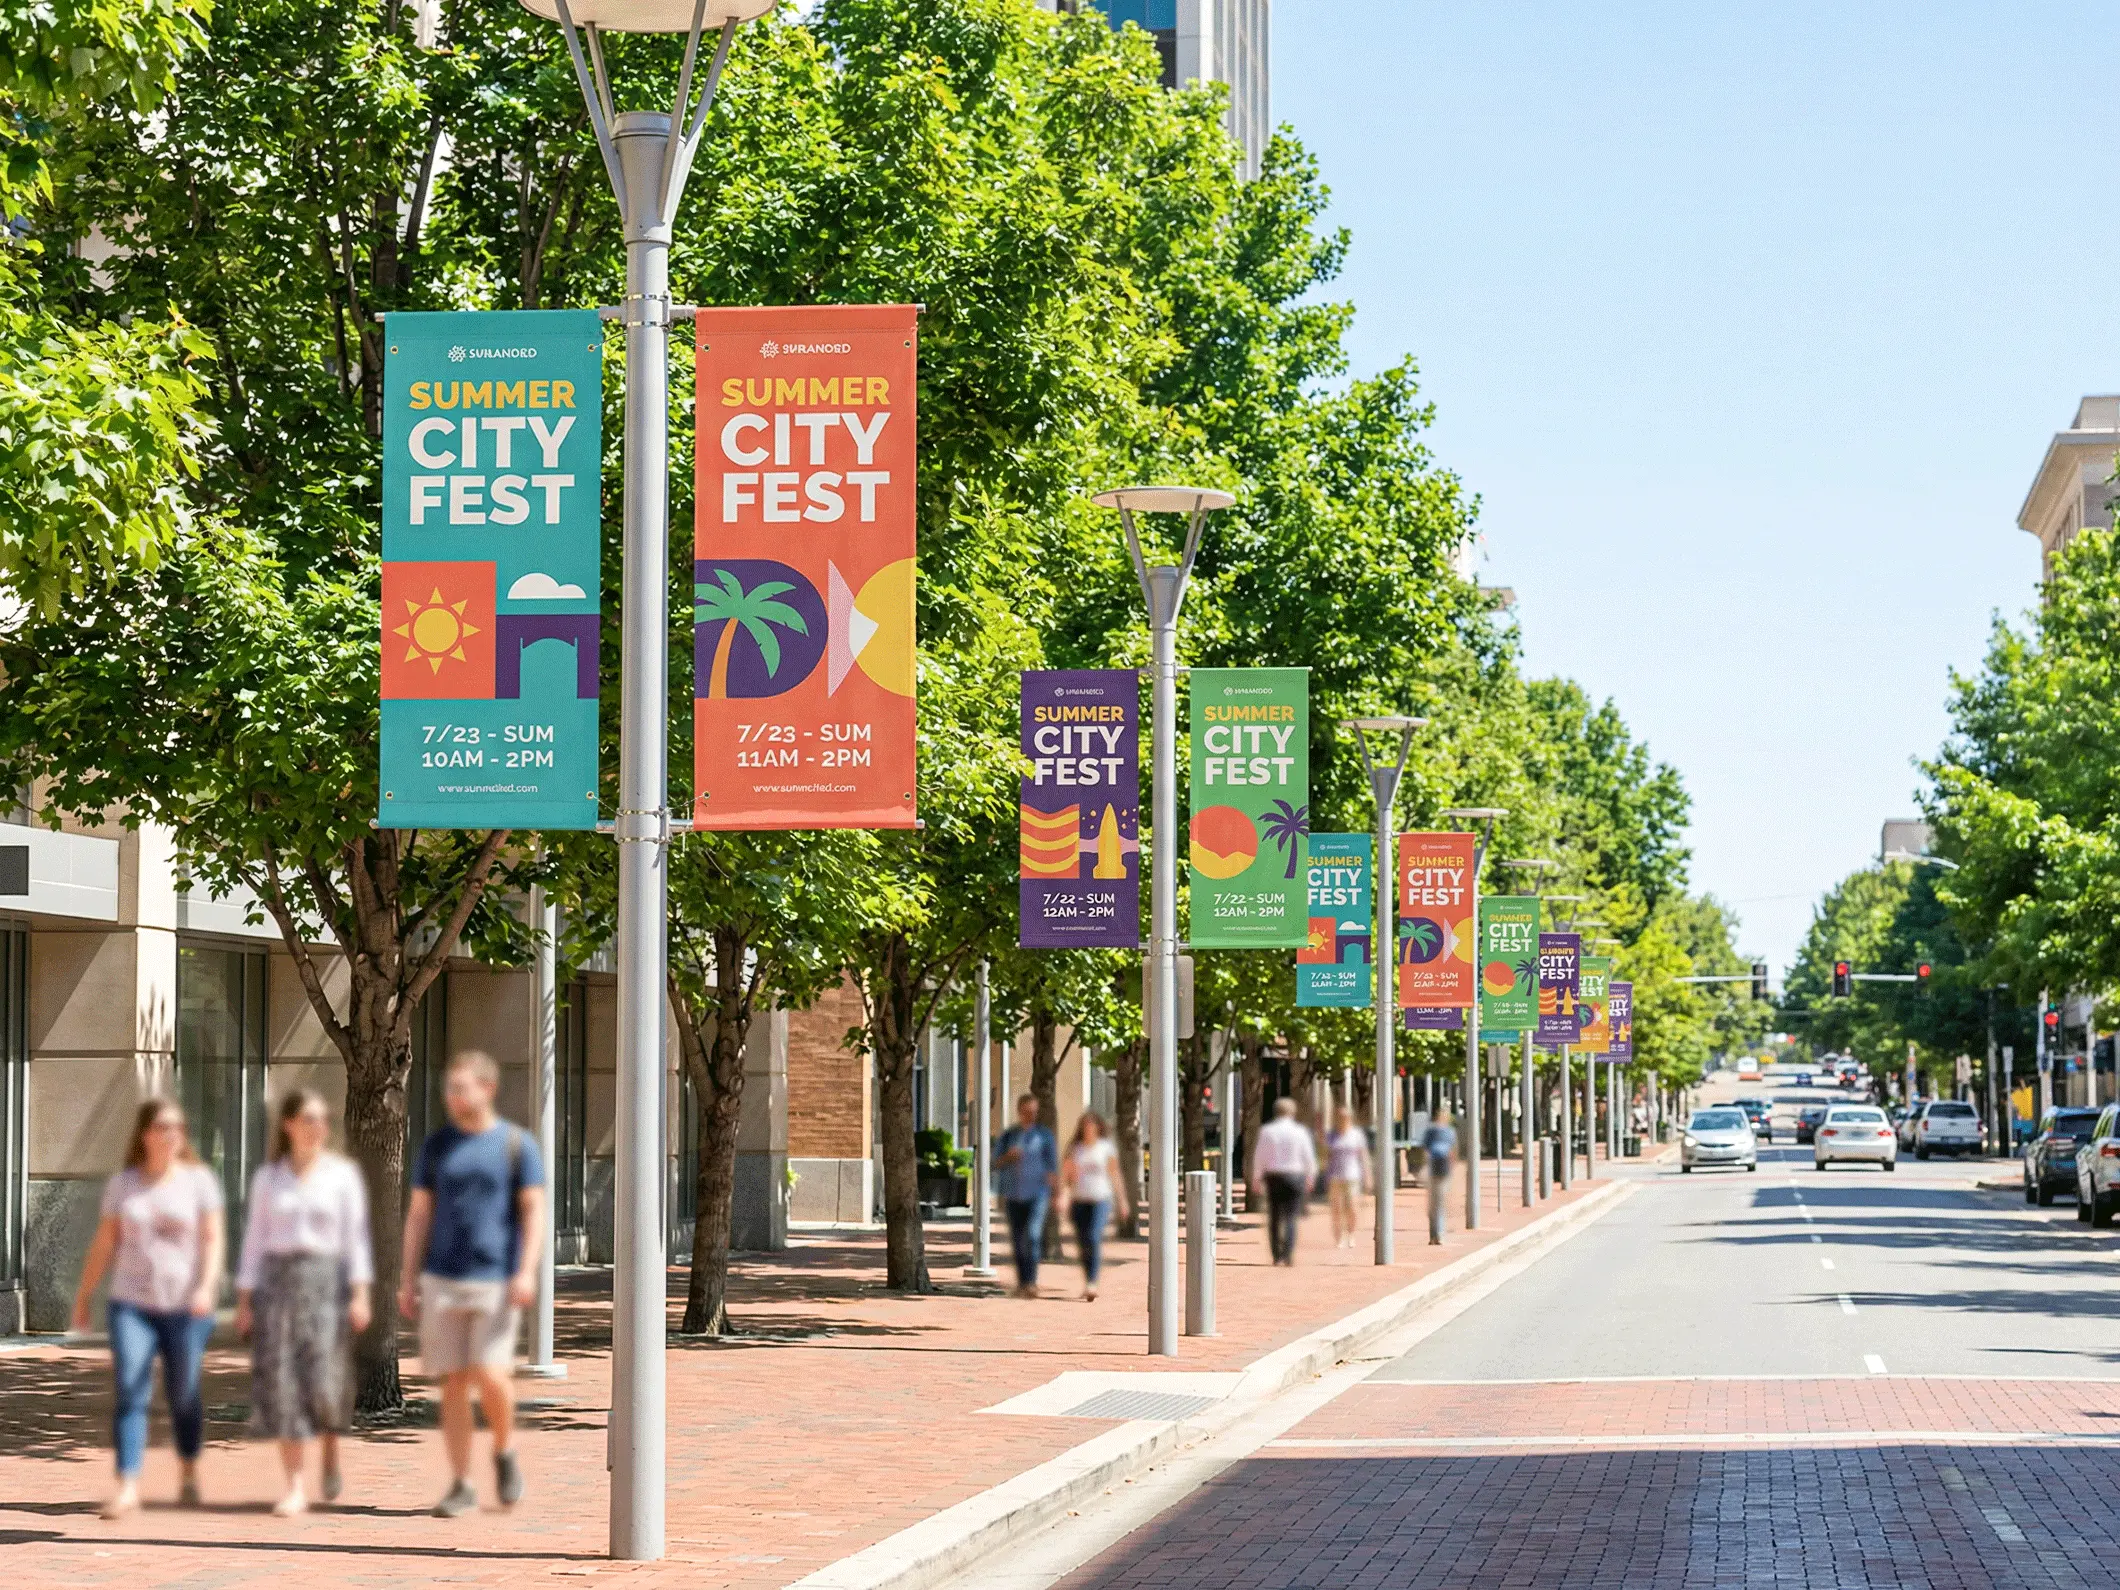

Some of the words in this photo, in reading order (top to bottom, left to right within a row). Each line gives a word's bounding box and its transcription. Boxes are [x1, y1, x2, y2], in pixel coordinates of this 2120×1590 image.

[409, 381, 576, 409] SUMMER
[721, 377, 890, 406] SUMMER
[409, 416, 576, 468] CITY
[720, 413, 890, 466] CITY
[409, 475, 574, 524] FEST
[723, 472, 890, 523] FEST
[1034, 706, 1124, 722] SUMMER
[1204, 706, 1294, 721] SUMMER
[423, 724, 480, 744] 7/23
[503, 725, 554, 743] SUM
[738, 723, 797, 743] 7/23
[820, 724, 871, 741] SUM
[1034, 726, 1124, 754] CITY
[1204, 726, 1294, 754] CITY
[422, 750, 482, 768] 10AM
[505, 750, 554, 768] 2PM
[737, 749, 800, 768] 11AM
[821, 750, 871, 768] 2PM
[1035, 758, 1124, 785] FEST
[1205, 758, 1294, 785] FEST
[1308, 857, 1362, 866] SUMMER
[1408, 856, 1464, 866] SUMMER
[1308, 868, 1362, 886] CITY
[1408, 868, 1464, 886] CITY
[1044, 894, 1075, 904] 7/22
[1087, 894, 1115, 904] SUM
[1214, 893, 1246, 904] 7/22
[1257, 893, 1284, 904] SUM
[1308, 888, 1362, 905] FEST
[1408, 888, 1464, 905] FEST
[1043, 907, 1077, 917] 12AM
[1089, 907, 1115, 917] 2PM
[1214, 907, 1247, 917] 12AM
[1259, 907, 1284, 917] 2PM
[1489, 924, 1532, 937] CITY
[1490, 939, 1532, 952] FEST
[1540, 956, 1574, 967] CITY
[1540, 969, 1574, 979] FEST
[1580, 987, 1603, 996] EST
[1609, 1008, 1629, 1016] EST
